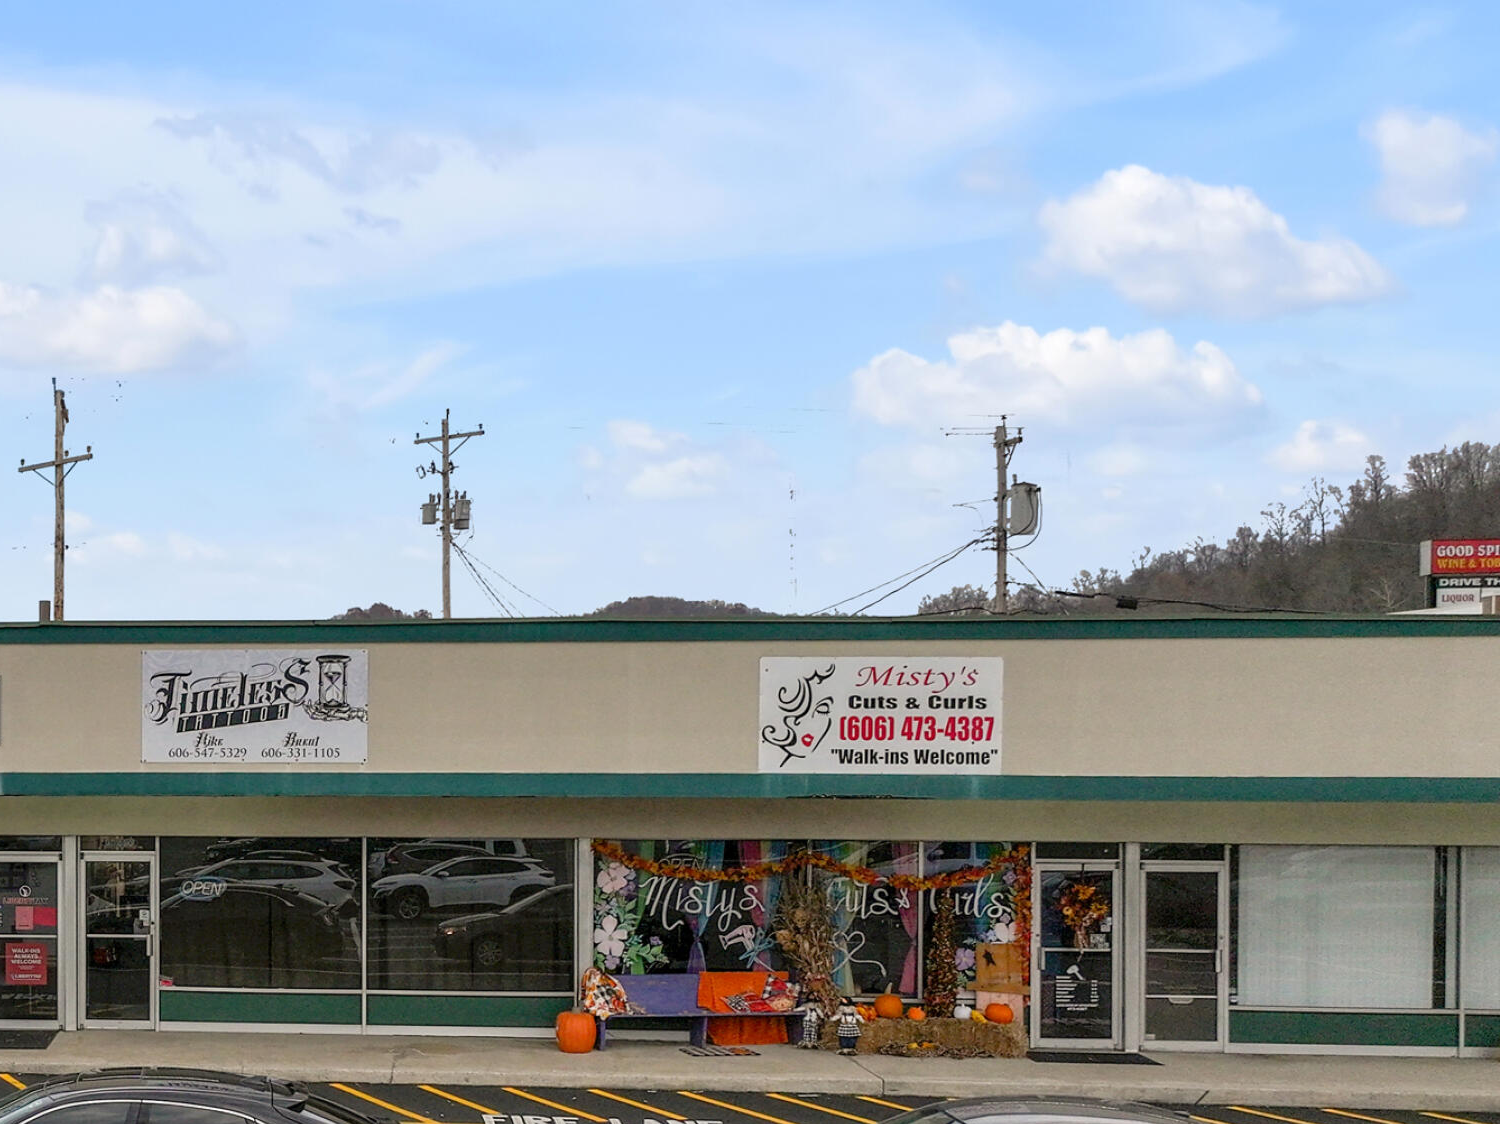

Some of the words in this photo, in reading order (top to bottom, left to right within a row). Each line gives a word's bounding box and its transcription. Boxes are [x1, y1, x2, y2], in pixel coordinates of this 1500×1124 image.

[1436, 545, 1474, 557] GOOD
[1437, 558, 1466, 569] WINE
[1468, 559, 1476, 568] &
[1438, 578, 1482, 587] DRIVE
[1442, 594, 1475, 604] LIQUOR
[855, 665, 980, 694] Misty's
[849, 696, 898, 710] Cuts
[905, 696, 920, 710] &
[928, 696, 988, 710] Curls
[839, 716, 895, 741] (606)
[901, 716, 995, 741] 473-4387
[168, 747, 247, 759] 606-547-5329
[261, 747, 340, 759] 606-331-1105
[831, 749, 909, 765] "Walk-ins
[914, 749, 999, 765] Welcome"
[182, 881, 222, 896] OPEN
